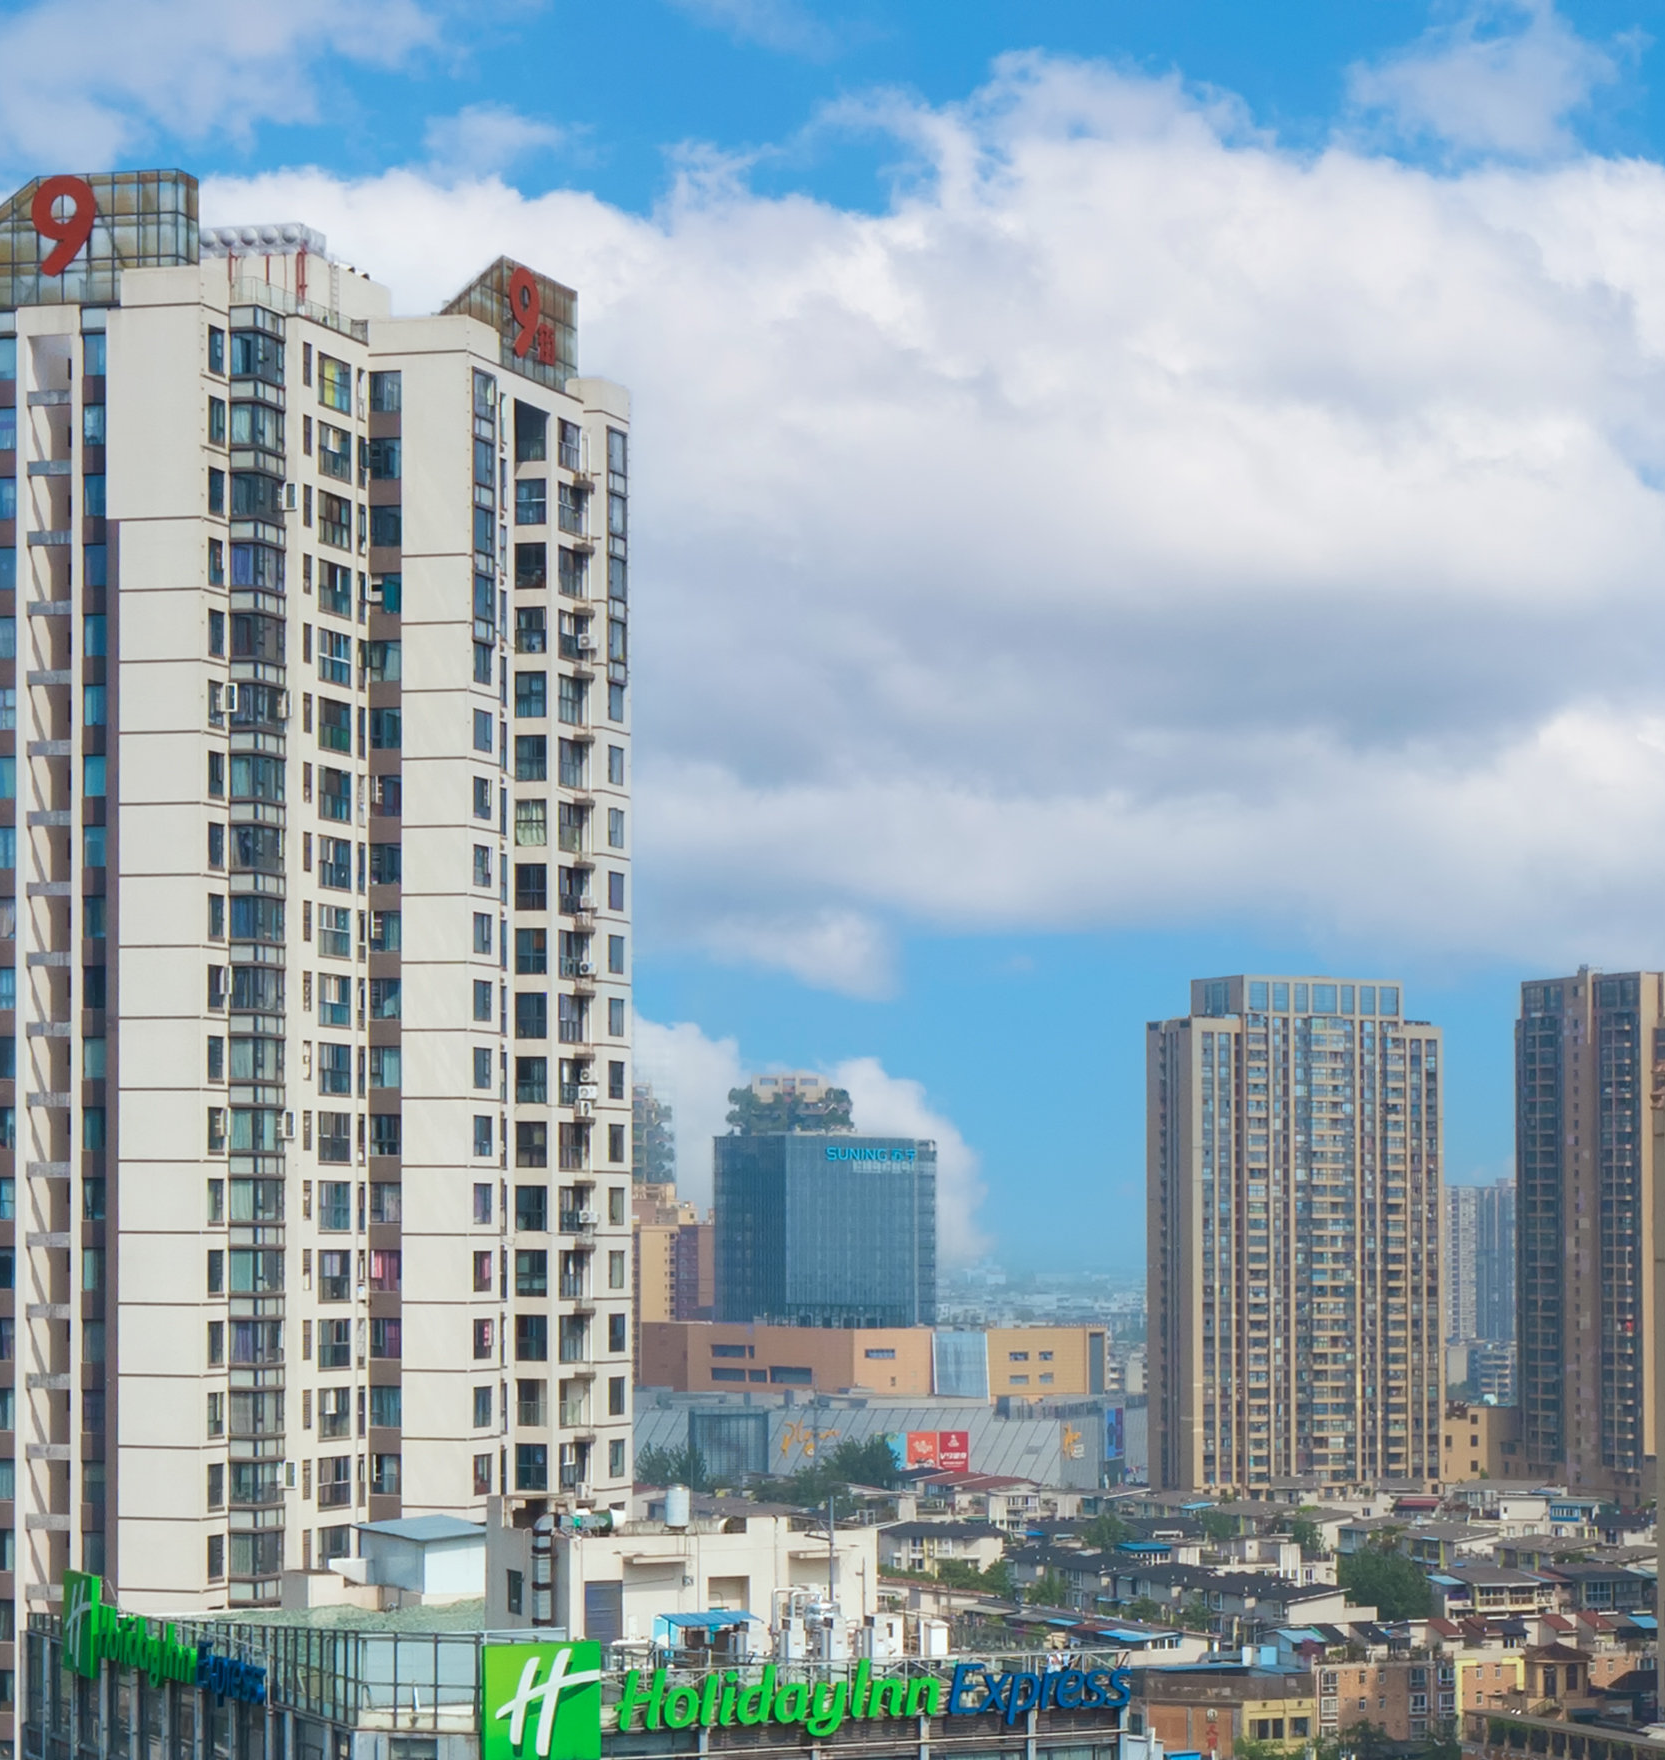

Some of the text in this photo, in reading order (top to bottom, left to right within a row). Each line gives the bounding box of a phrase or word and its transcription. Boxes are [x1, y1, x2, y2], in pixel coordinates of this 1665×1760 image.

[31, 175, 96, 277] 9
[826, 1147, 887, 1162] SUNING
[949, 1663, 1131, 1726] Express
